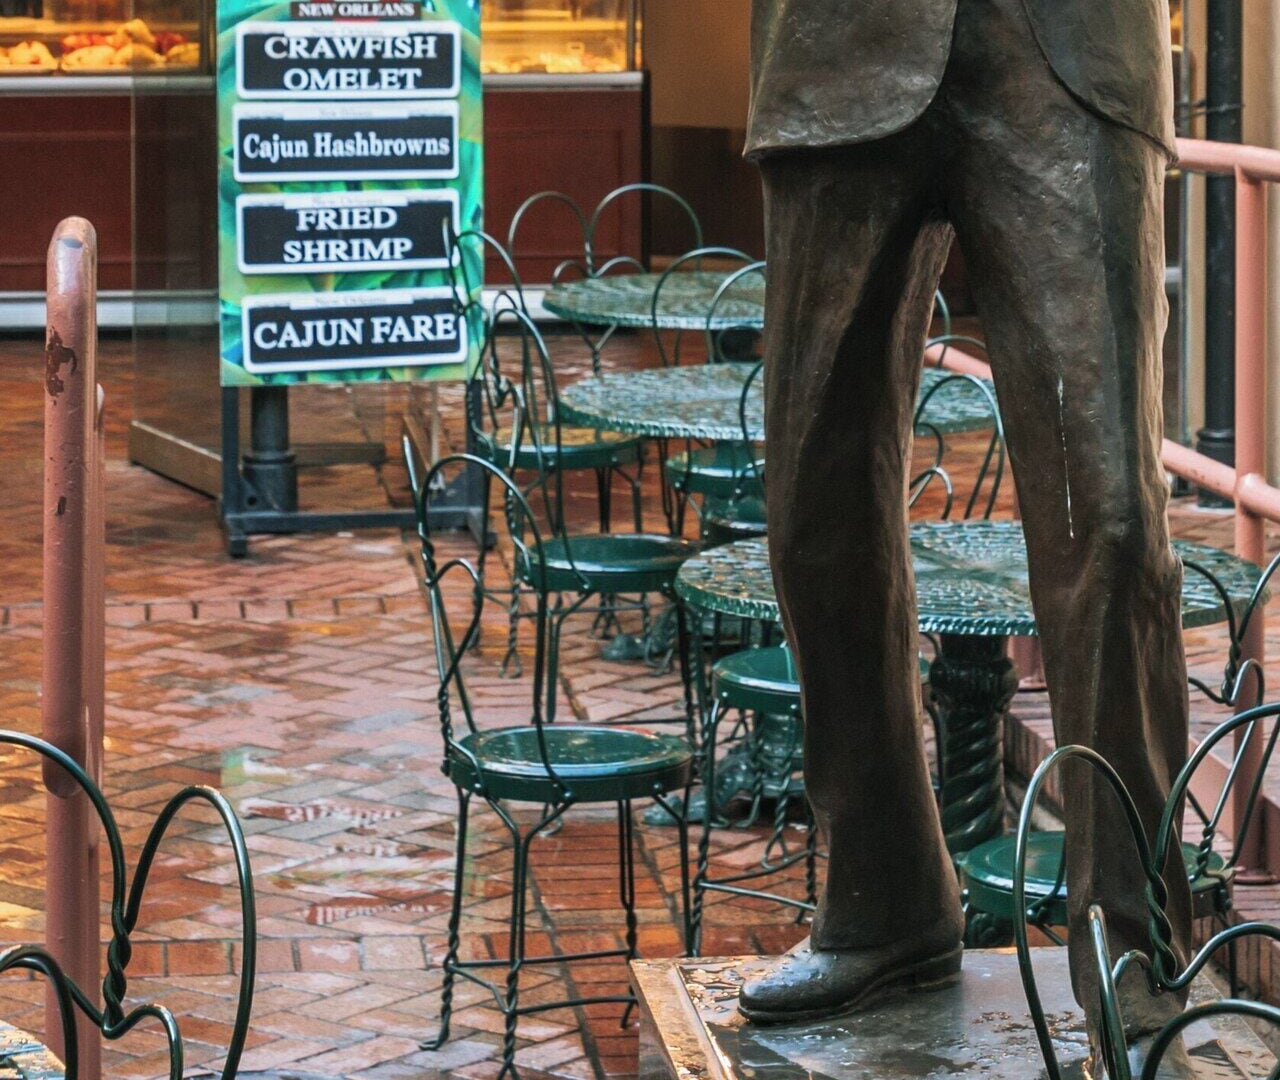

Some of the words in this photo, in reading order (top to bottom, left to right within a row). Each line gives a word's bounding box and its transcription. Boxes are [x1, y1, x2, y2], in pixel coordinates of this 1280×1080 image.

[298, 2, 336, 17] NEW
[338, 2, 416, 17] ORLEANS
[263, 36, 438, 60] CRAWFISH
[282, 67, 423, 91] OMELET
[242, 133, 310, 164] Cajun
[313, 131, 451, 158] Hashbrowns
[295, 206, 399, 232] FRIED
[282, 237, 414, 264] SHRIMP
[252, 318, 366, 350] CAJUN
[370, 313, 458, 344] FARE
